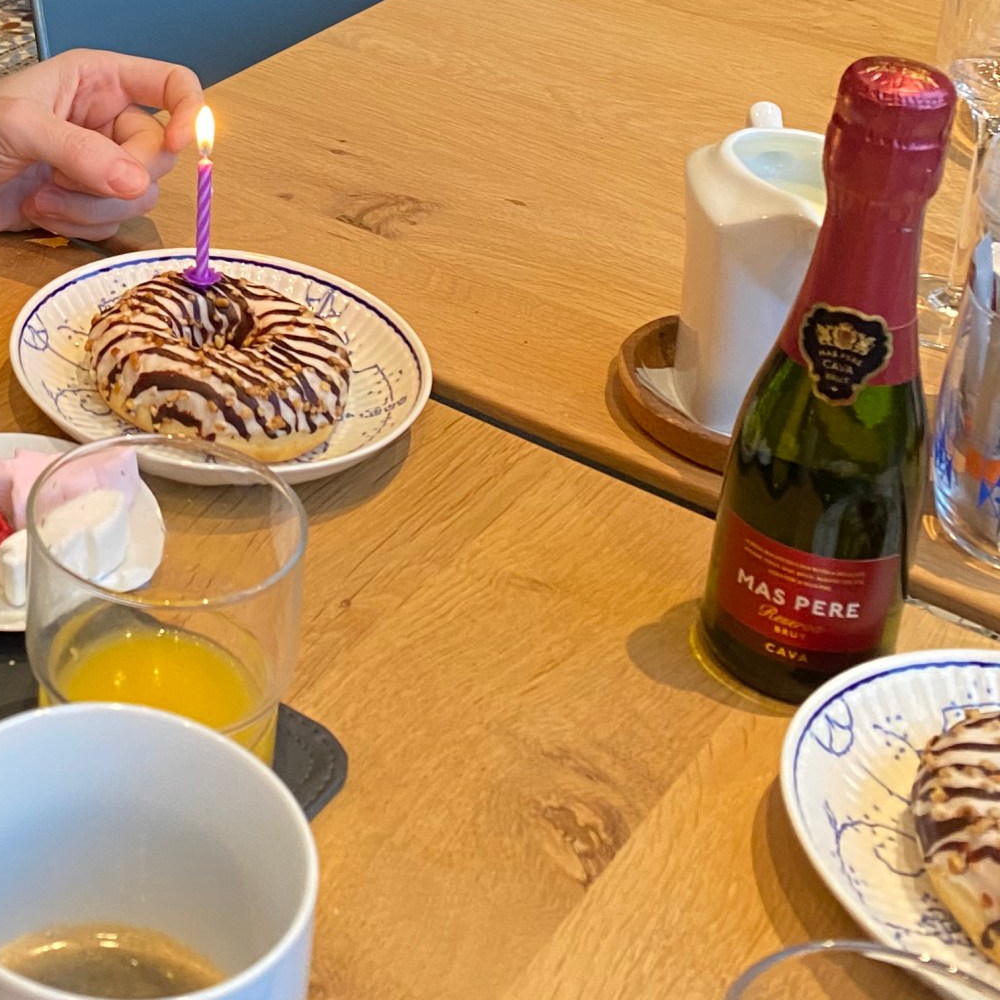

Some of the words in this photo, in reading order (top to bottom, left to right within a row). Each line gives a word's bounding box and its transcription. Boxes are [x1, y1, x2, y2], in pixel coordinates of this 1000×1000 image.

[737, 567, 786, 606] MAS
[794, 594, 861, 619] PERE
[773, 624, 806, 641] BRUT
[764, 641, 809, 663] CAVA
